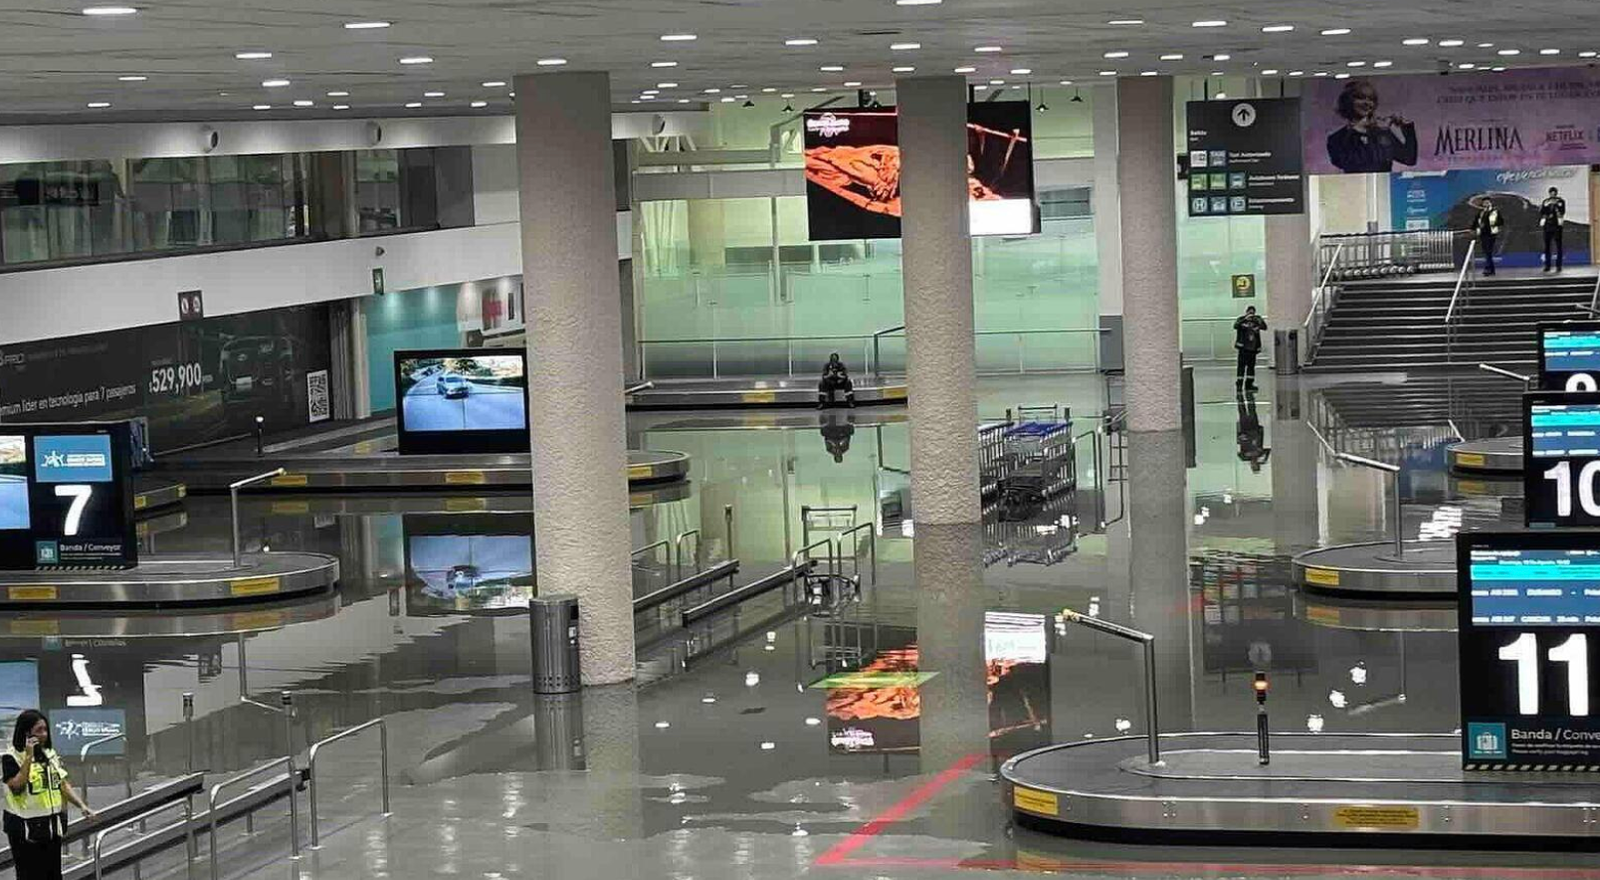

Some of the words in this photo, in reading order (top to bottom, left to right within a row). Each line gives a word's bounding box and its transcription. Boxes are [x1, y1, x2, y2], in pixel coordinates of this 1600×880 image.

[1434, 125, 1524, 156] MERLINA
[1546, 129, 1585, 143] NETFLIX
[1543, 460, 1600, 517] 10
[55, 485, 92, 535] 7
[1499, 633, 1588, 716] 11
[1510, 728, 1553, 740] Banda
